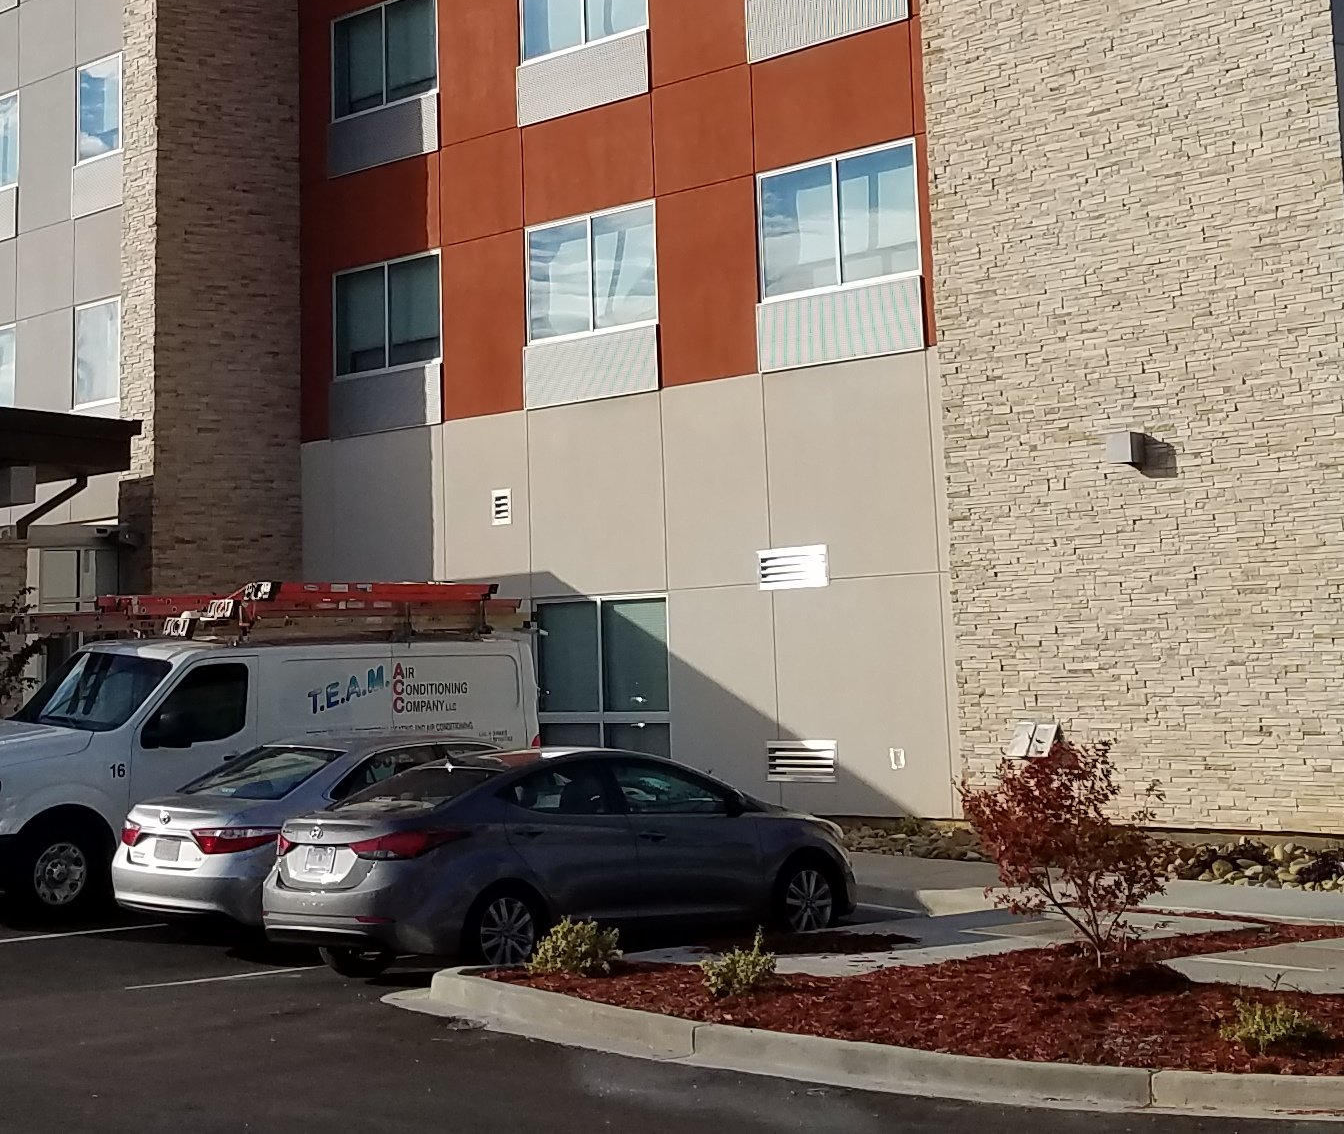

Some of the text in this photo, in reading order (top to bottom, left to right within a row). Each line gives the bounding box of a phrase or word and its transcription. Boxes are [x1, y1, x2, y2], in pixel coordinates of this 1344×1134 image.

[392, 662, 415, 680] AIR
[307, 665, 390, 715] T.E.A.M.
[392, 678, 468, 696] CONDITIONING
[392, 696, 444, 714] COMPANY
[109, 763, 126, 778] 16
